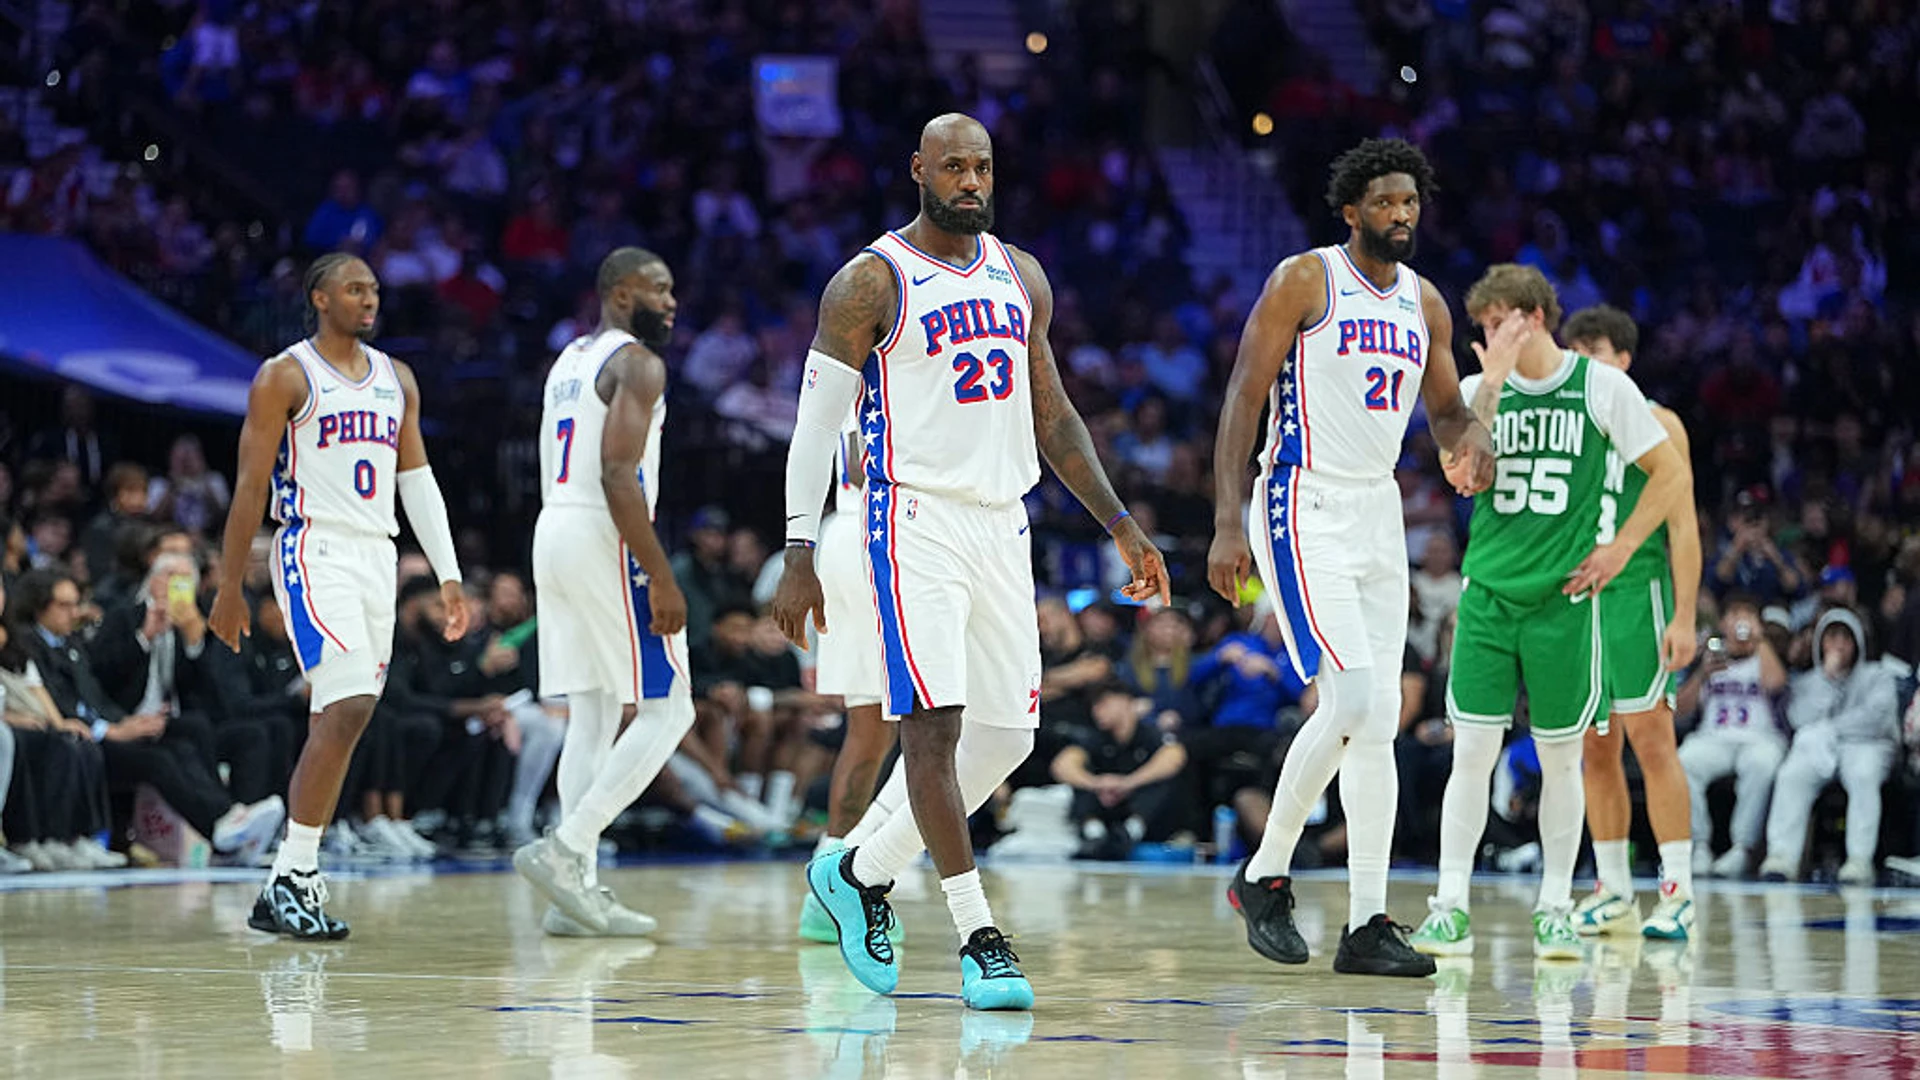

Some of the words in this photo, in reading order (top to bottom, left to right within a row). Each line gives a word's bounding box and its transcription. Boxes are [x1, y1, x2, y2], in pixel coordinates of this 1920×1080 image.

[919, 298, 1027, 358] PHILA
[1337, 318, 1422, 369] PHILA
[952, 349, 1015, 404] 23
[1365, 366, 1404, 412] 21
[556, 417, 575, 484] 7
[1491, 407, 1585, 458] BOSTON
[354, 459, 376, 500] 0
[1493, 457, 1573, 515] 55
